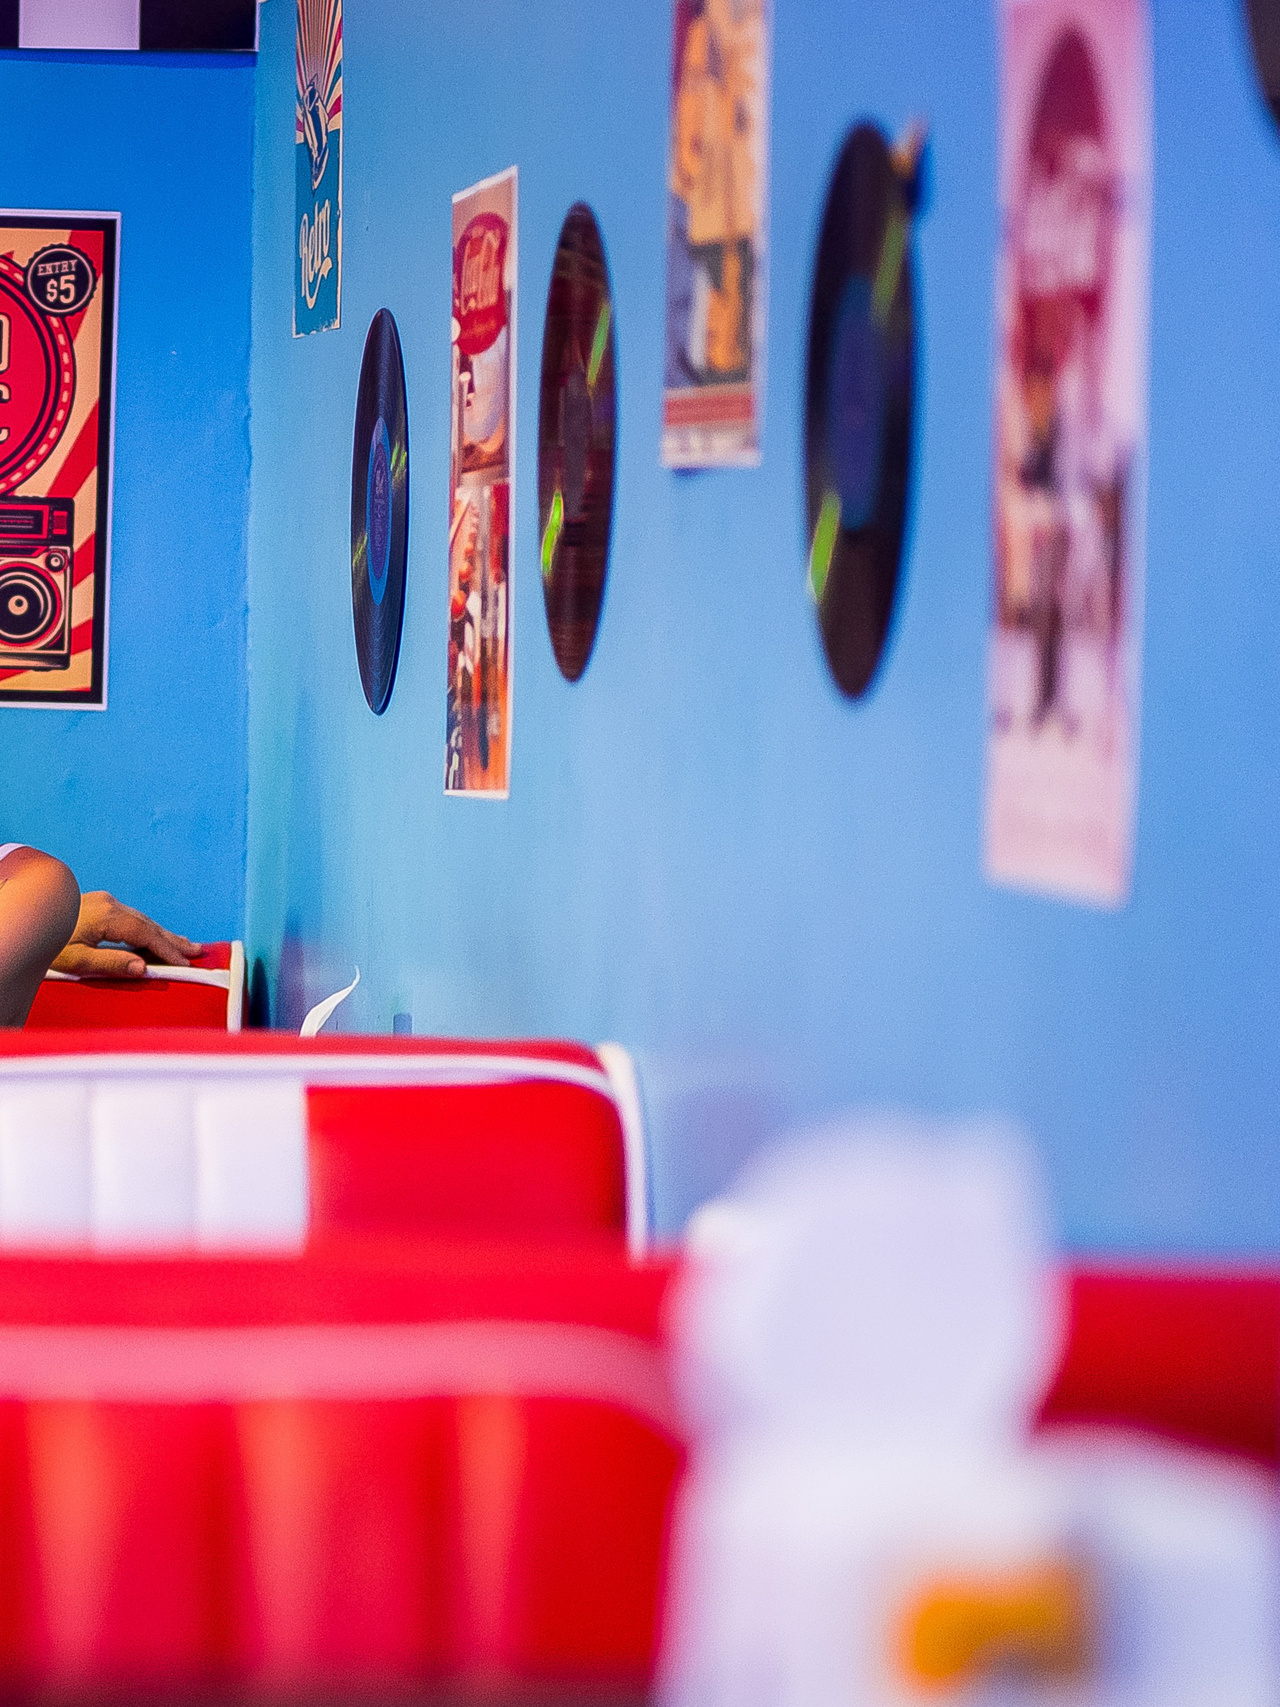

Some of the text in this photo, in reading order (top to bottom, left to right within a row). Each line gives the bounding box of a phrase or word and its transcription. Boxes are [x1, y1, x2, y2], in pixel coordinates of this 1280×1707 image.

[37, 259, 78, 276] ENTRY
[299, 198, 333, 310] Retro
[46, 275, 76, 304] $5
